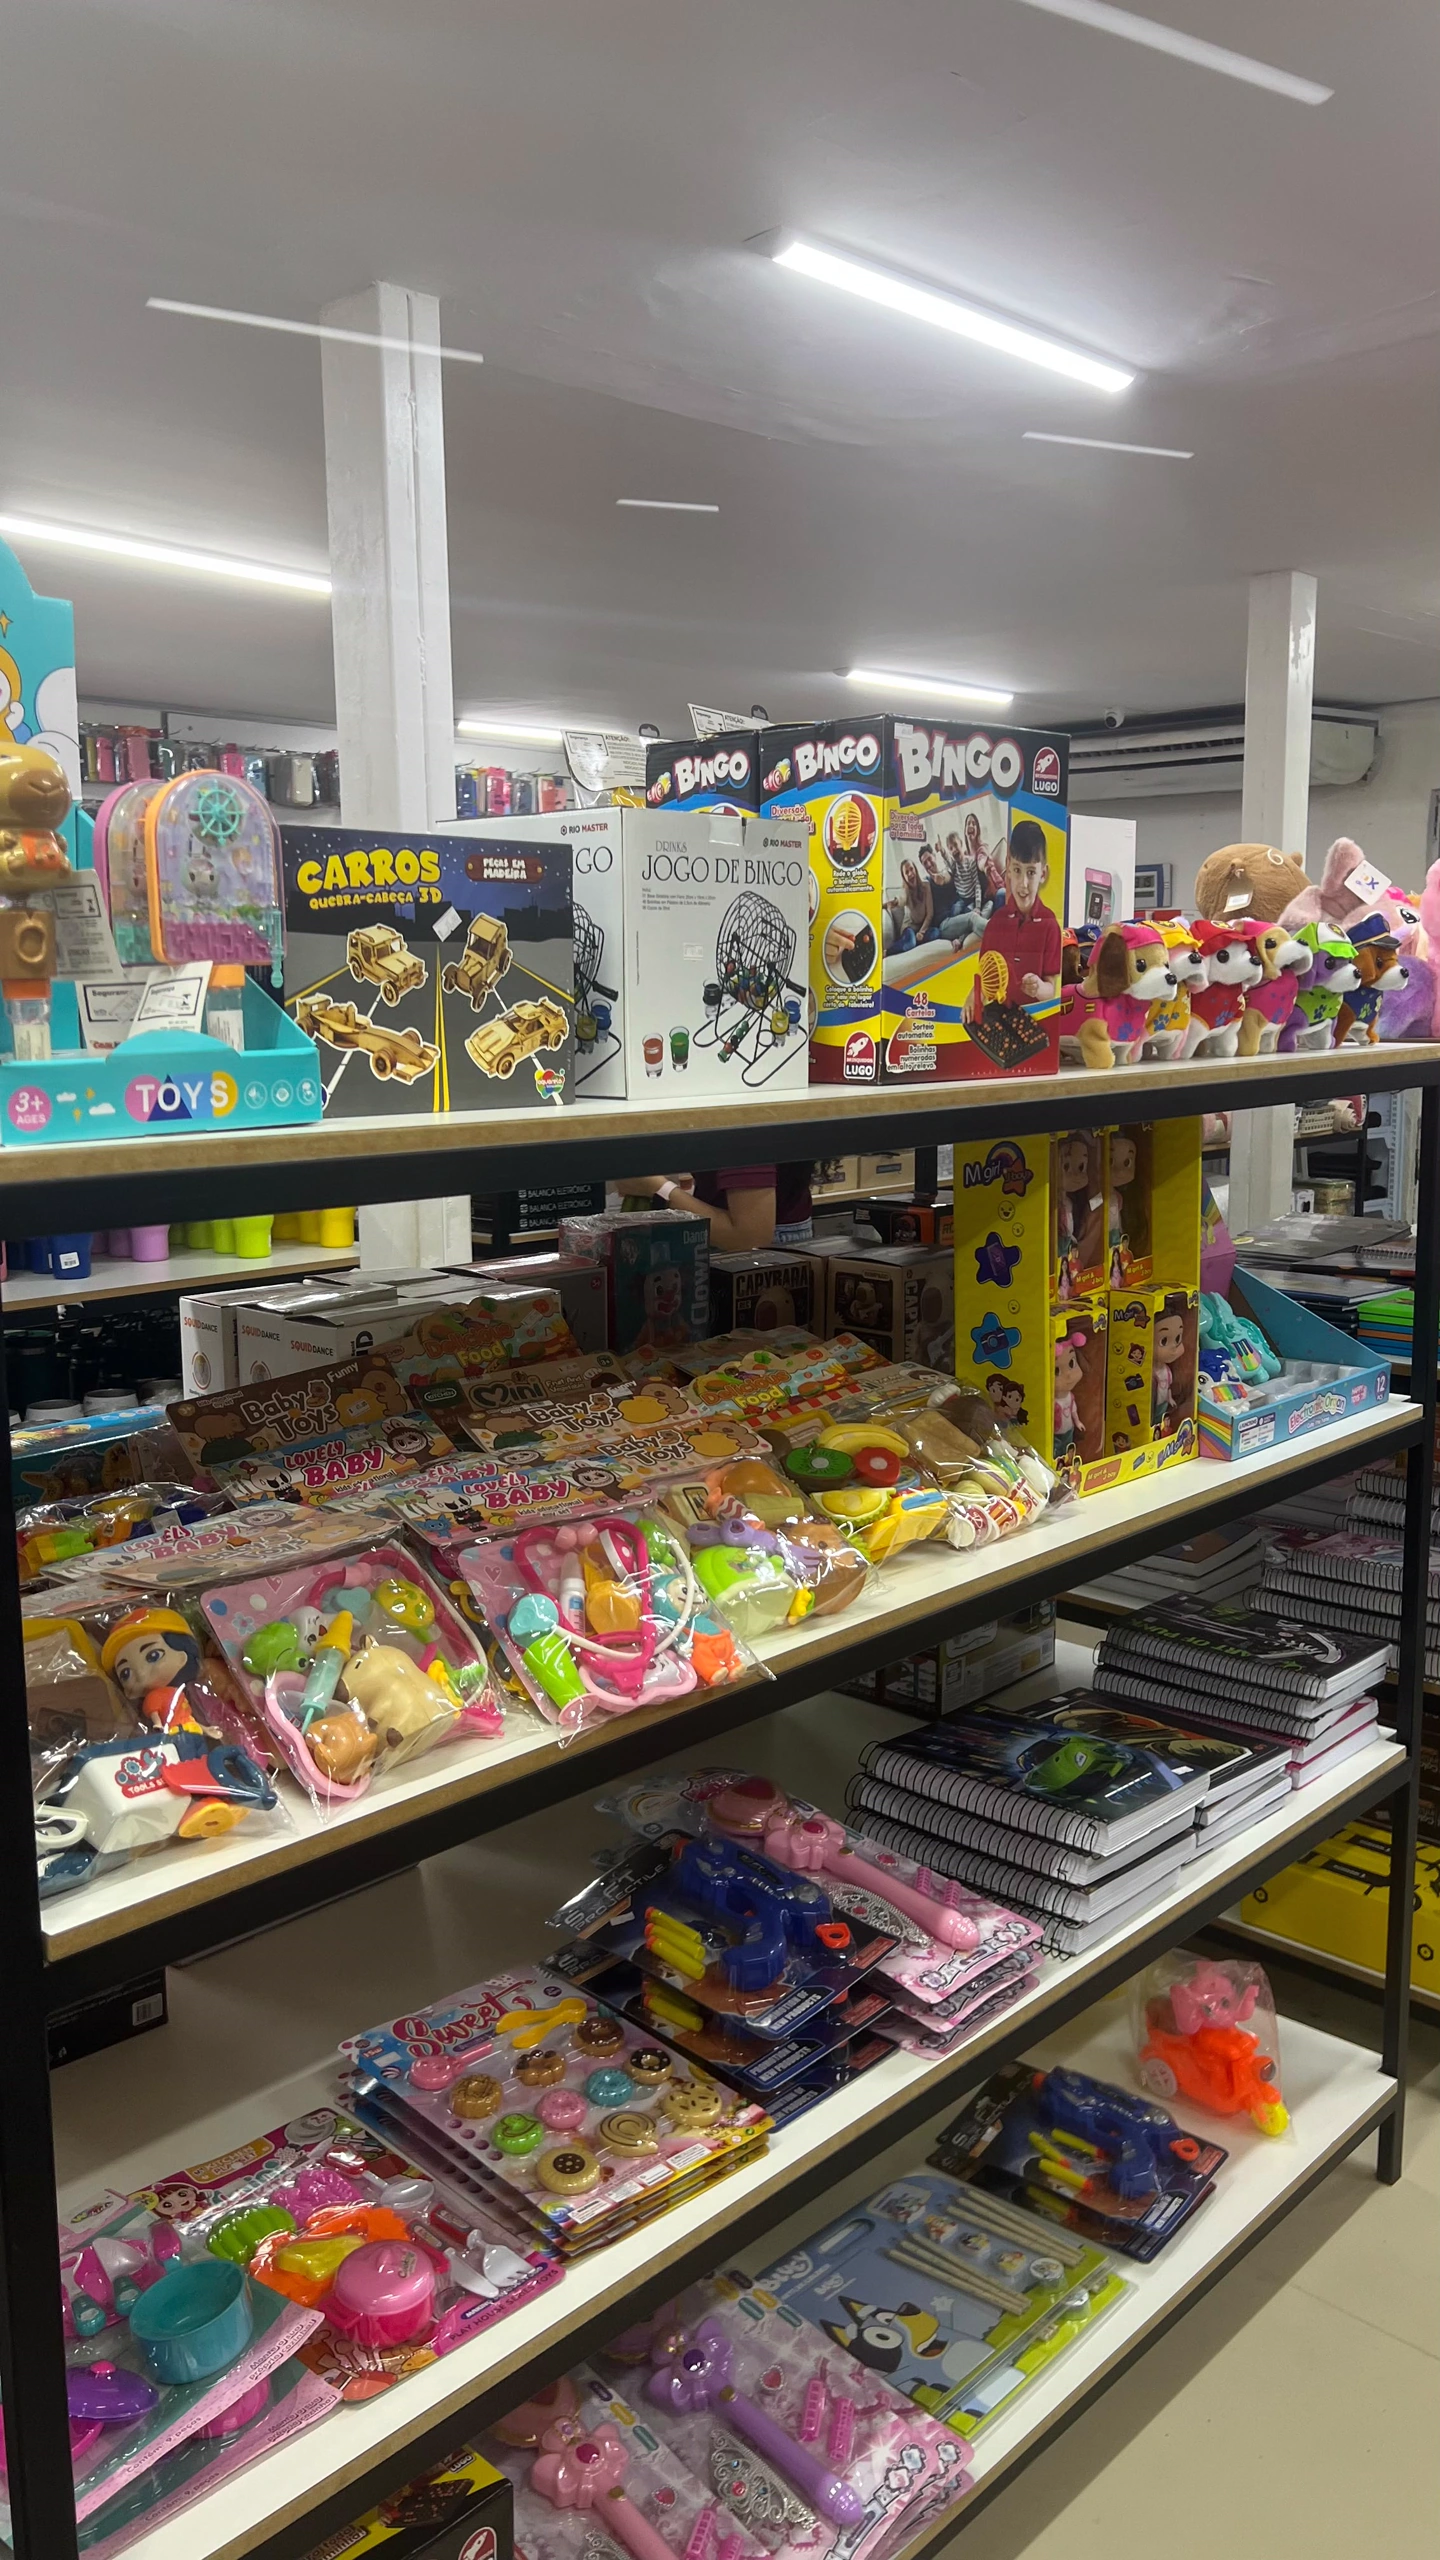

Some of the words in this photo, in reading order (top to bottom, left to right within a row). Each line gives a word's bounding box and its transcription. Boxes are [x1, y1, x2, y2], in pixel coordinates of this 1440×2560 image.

[794, 735, 880, 784] BINGO
[897, 729, 1022, 794] BINGO
[674, 751, 750, 796] BINGO
[1034, 781, 1058, 792] LUGO
[770, 804, 806, 817] Diversão
[890, 809, 919, 822] Diversão
[568, 826, 580, 834] RIO
[581, 823, 609, 833] MASTER
[655, 840, 688, 853] DRINKS
[769, 839, 780, 848] RIO
[780, 840, 803, 849] MASTER
[297, 848, 442, 895] CARROS
[483, 858, 509, 870] PEÇAS
[511, 858, 527, 870] EM
[641, 854, 710, 884] JOGO
[714, 858, 740, 884] DE
[744, 859, 803, 887] BINGO
[418, 886, 443, 904] 3D
[912, 992, 928, 1006] 48
[905, 1007, 935, 1018] Cartelas
[912, 1022, 935, 1031] Sorteio
[900, 1053, 936, 1063] numeradas
[909, 1045, 936, 1055] Bolinhas
[846, 1065, 873, 1077] LUGO
[15, 1092, 44, 1113] 3+
[135, 1079, 230, 1114] TOYS
[16, 1113, 47, 1125] AGES
[965, 1166, 982, 1185] M
[983, 1160, 1001, 1184] girl
[456, 1340, 508, 1368] Food
[326, 1361, 359, 1384] Funny
[1376, 1375, 1386, 1391] 12
[471, 1377, 547, 1408] Mini
[734, 1385, 786, 1410] Food
[241, 1388, 308, 1425] Baby
[527, 1398, 591, 1424] Baby
[551, 1405, 624, 1433] Toys
[1289, 1397, 1325, 1429] Electronic
[266, 1402, 339, 1442] Toys
[284, 1440, 346, 1470] LOVELY
[597, 1429, 661, 1457] Baby
[626, 1439, 696, 1468] Toys
[303, 1447, 384, 1488] BABY
[463, 1471, 530, 1495] LOVELY
[482, 1479, 571, 1510] BABY
[123, 1524, 194, 1553] LOVELY
[149, 1525, 242, 1560] BABY
[128, 1781, 156, 1794] TOOLS
[574, 1863, 666, 1931] PROJECTILE
[788, 1993, 822, 2018] PRODUCTS
[392, 1979, 537, 2059] Sweet
[776, 2046, 812, 2071] PRODUCTS
[450, 2324, 473, 2340] PLAY
[473, 2305, 505, 2327] HOUSE
[536, 2269, 559, 2285] TOYS
[249, 2352, 284, 2380] própria
[282, 2319, 317, 2354] cozinha!
[250, 2344, 280, 2370] Monte
[286, 2325, 304, 2340] sua
[268, 2412, 300, 2433] Monte
[305, 2396, 323, 2410] sua
[174, 2417, 203, 2438] peças
[450, 2455, 473, 2472] LUGO
